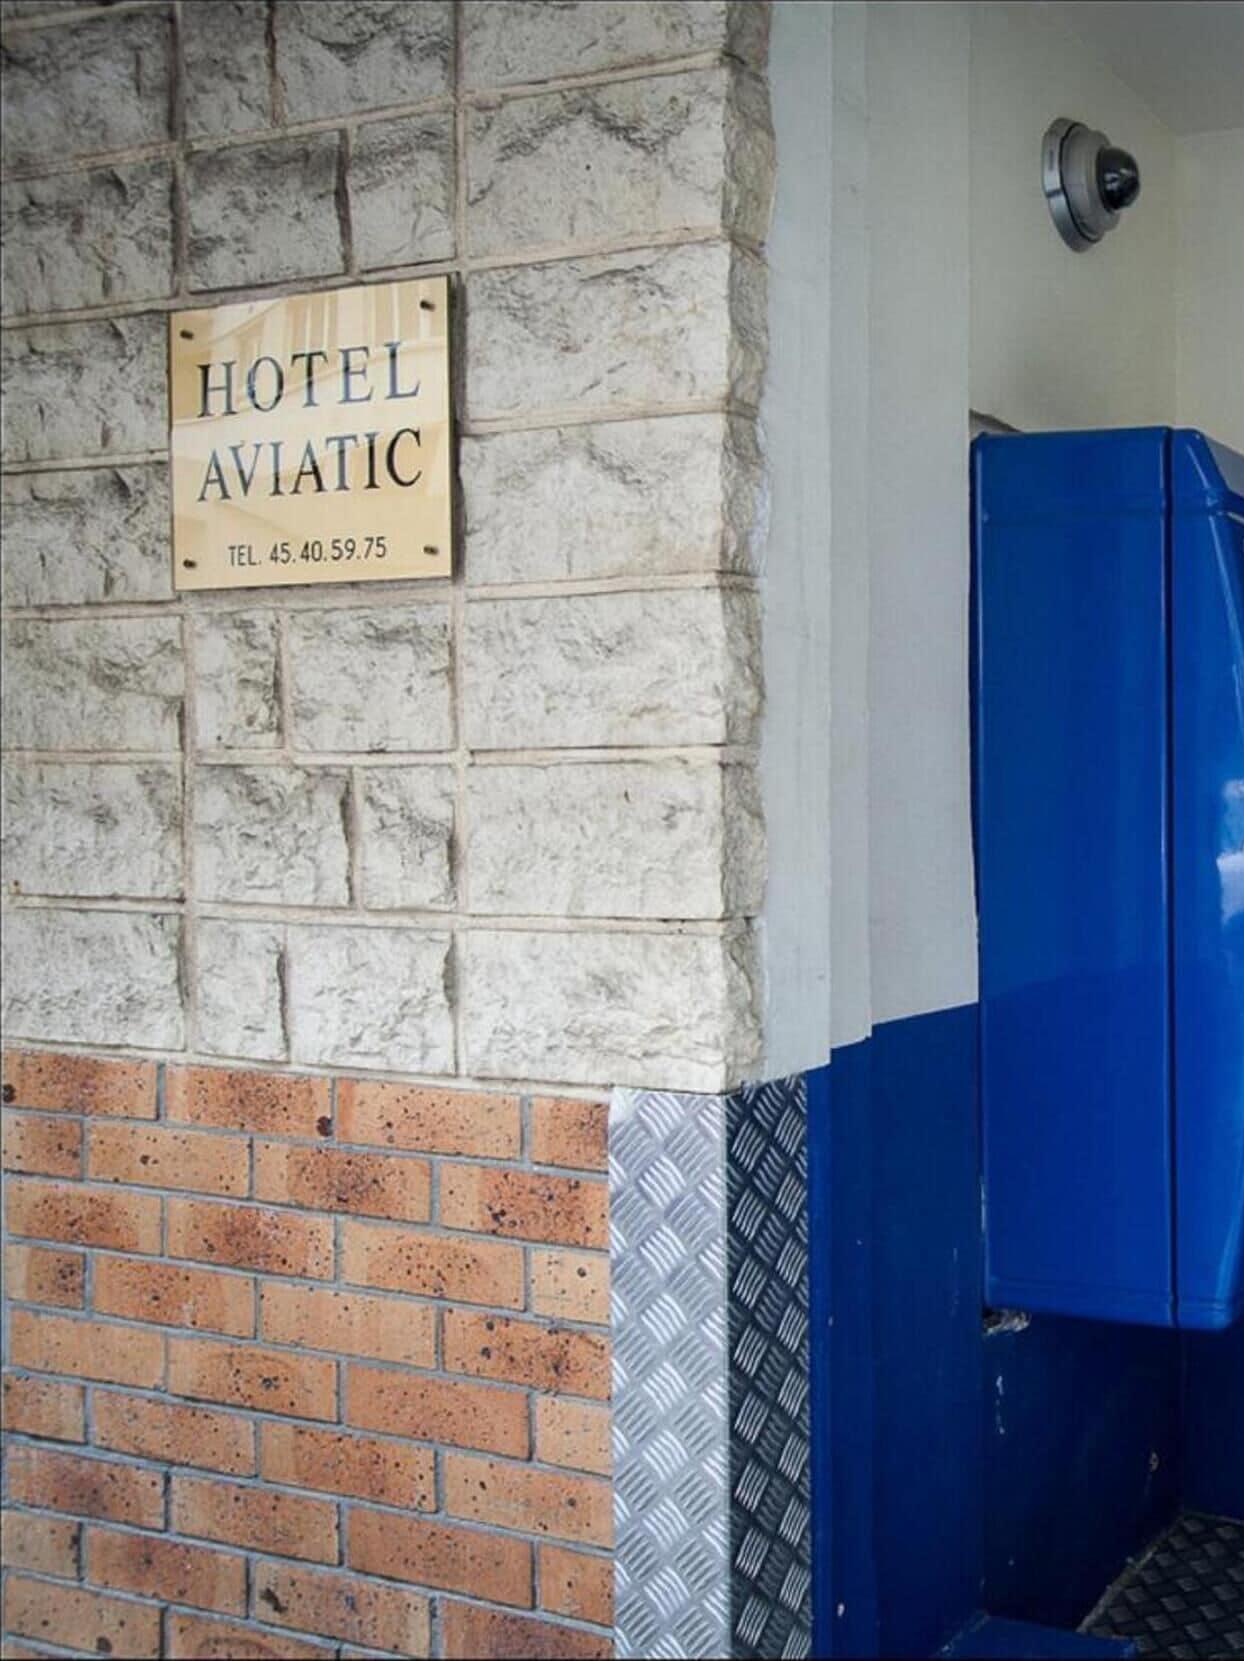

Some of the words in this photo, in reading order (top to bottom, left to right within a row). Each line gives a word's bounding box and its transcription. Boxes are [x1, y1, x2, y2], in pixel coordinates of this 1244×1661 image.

[196, 341, 421, 418] HOTEL
[197, 427, 422, 502] AVIATIC
[228, 544, 262, 567] TEL.
[269, 536, 388, 565] 45.40.59.75
